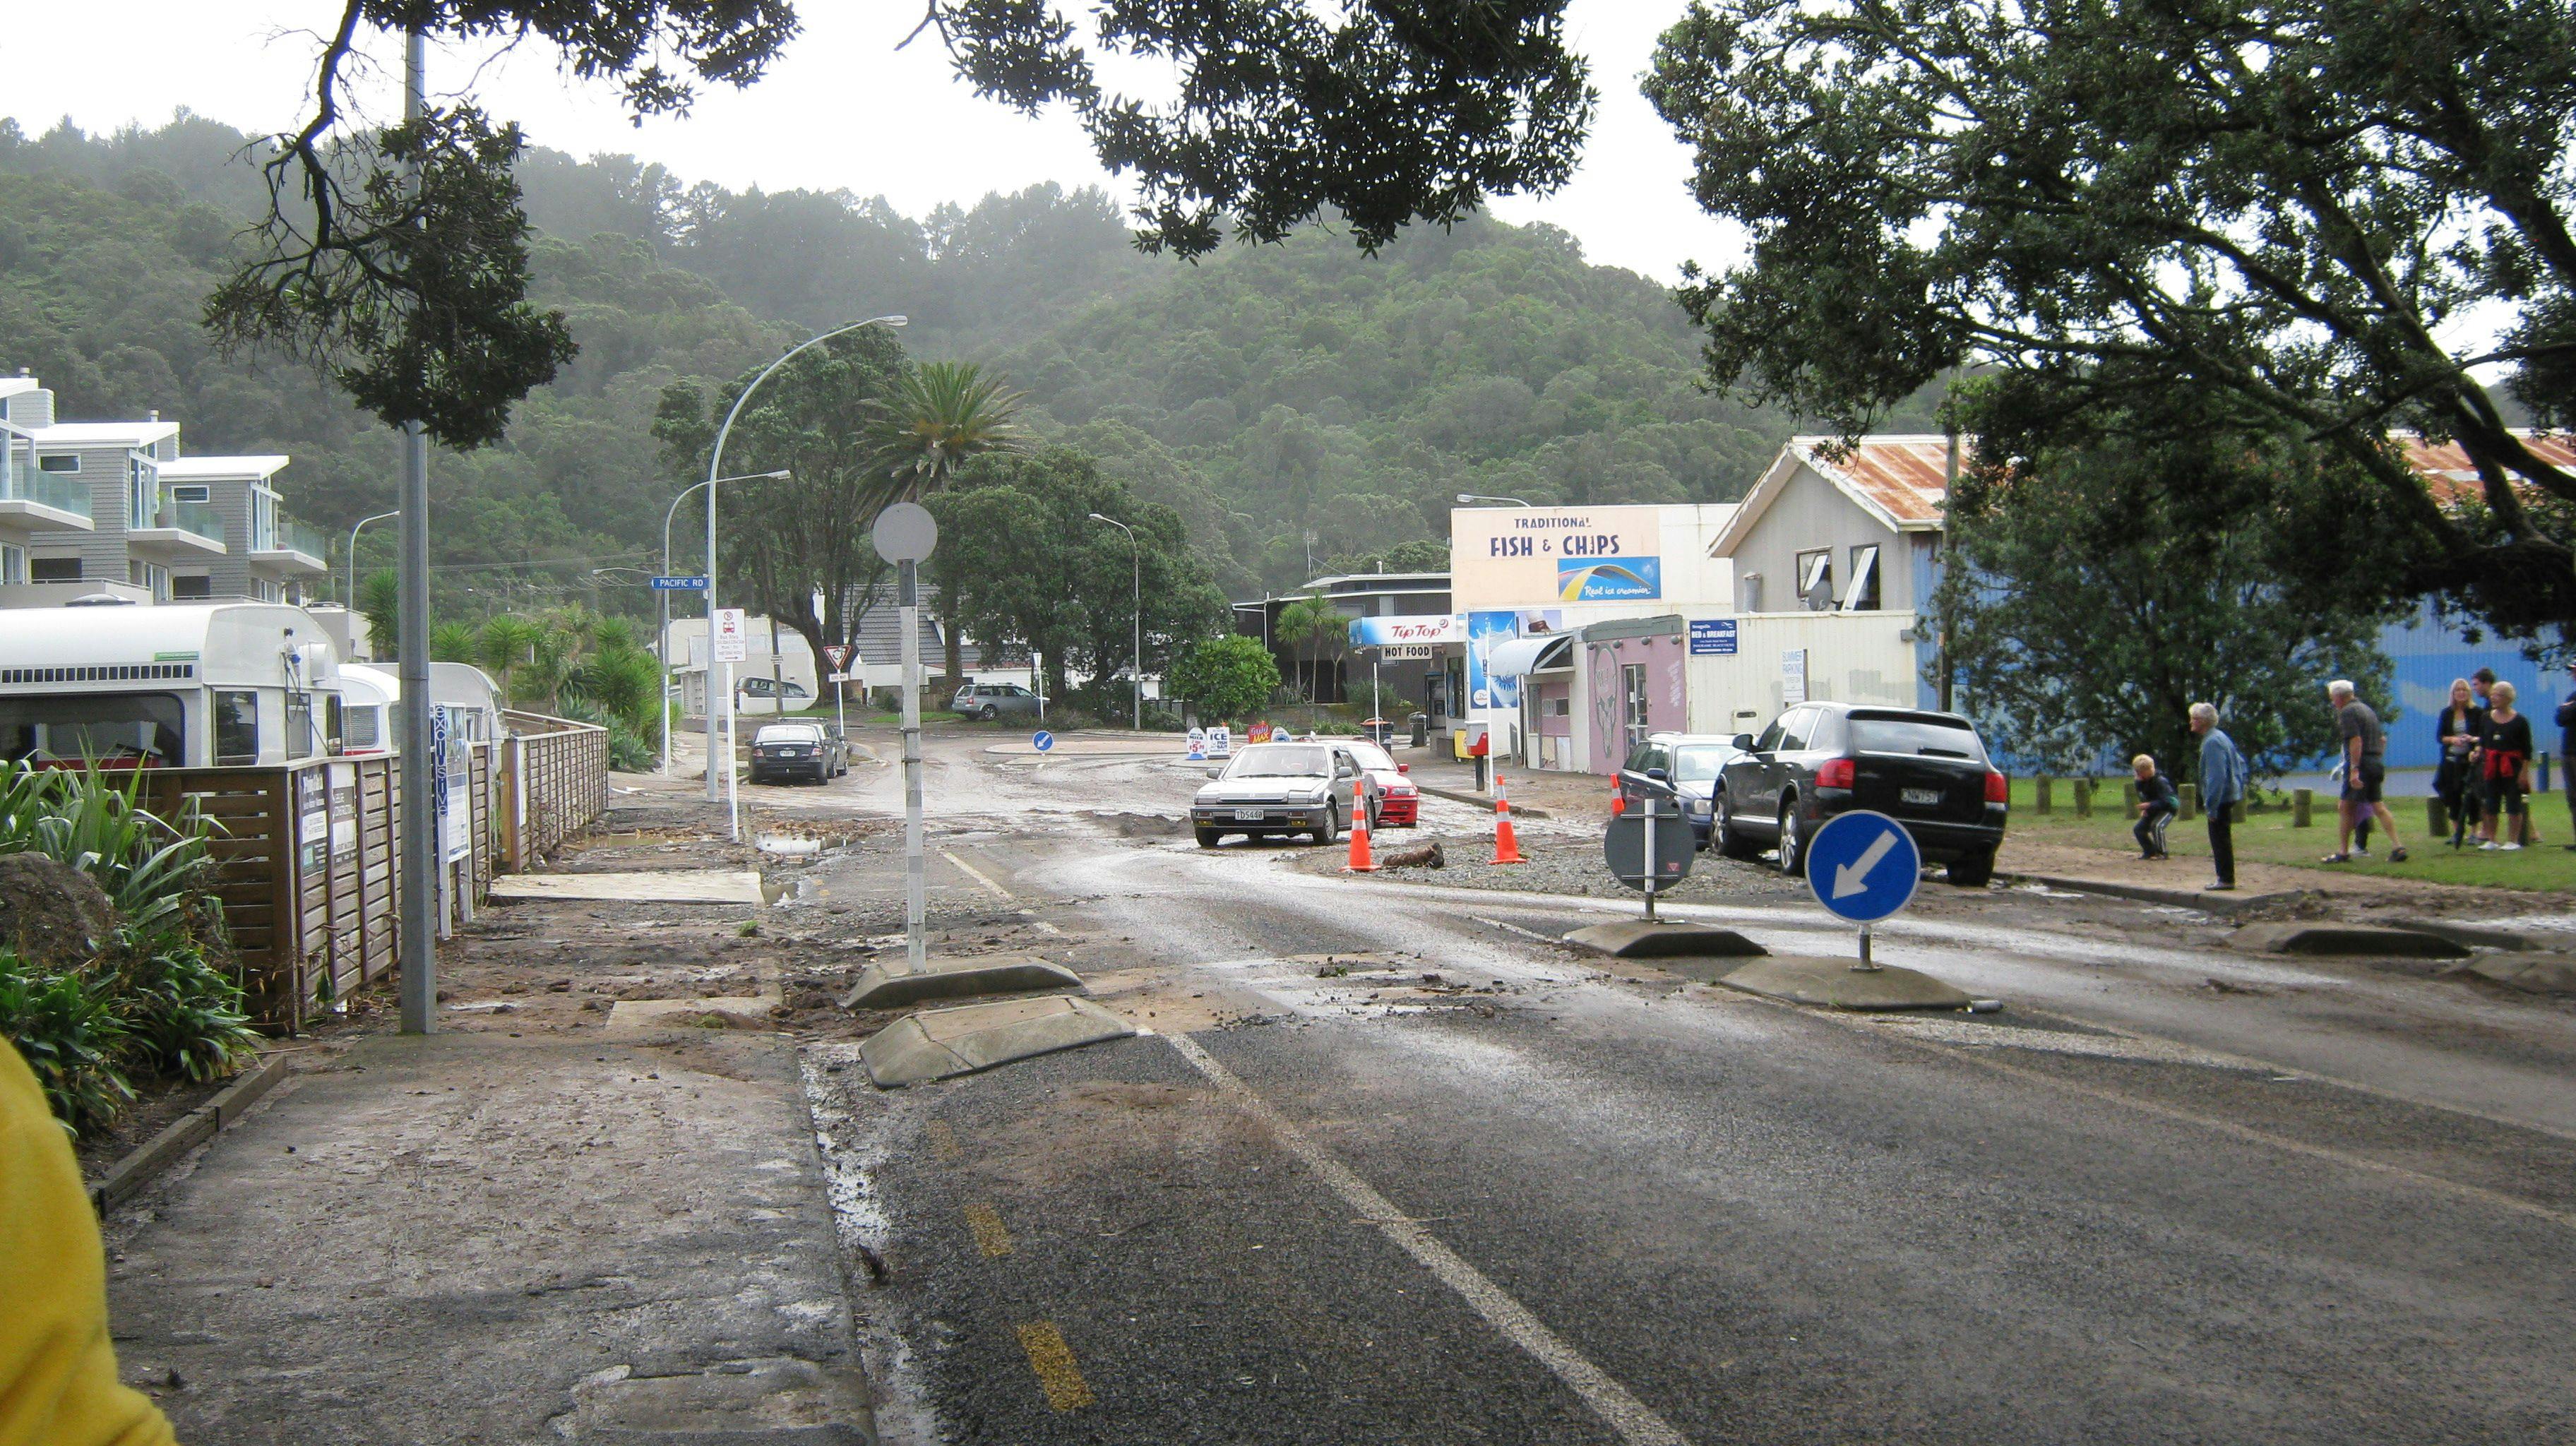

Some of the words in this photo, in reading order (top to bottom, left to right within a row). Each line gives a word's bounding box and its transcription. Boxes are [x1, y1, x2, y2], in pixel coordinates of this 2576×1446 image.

[1514, 518, 1591, 528] TRADITIONAL
[1491, 537, 1532, 556] FISH
[1542, 539, 1551, 551] &
[1563, 534, 1620, 555] CHIPS
[1584, 585, 1603, 597] Real
[1391, 626, 1414, 639] Tip
[1415, 625, 1441, 638] Top
[1385, 647, 1402, 657] HOT
[1406, 647, 1429, 657] FOOD
[436, 706, 448, 817] exclusive
